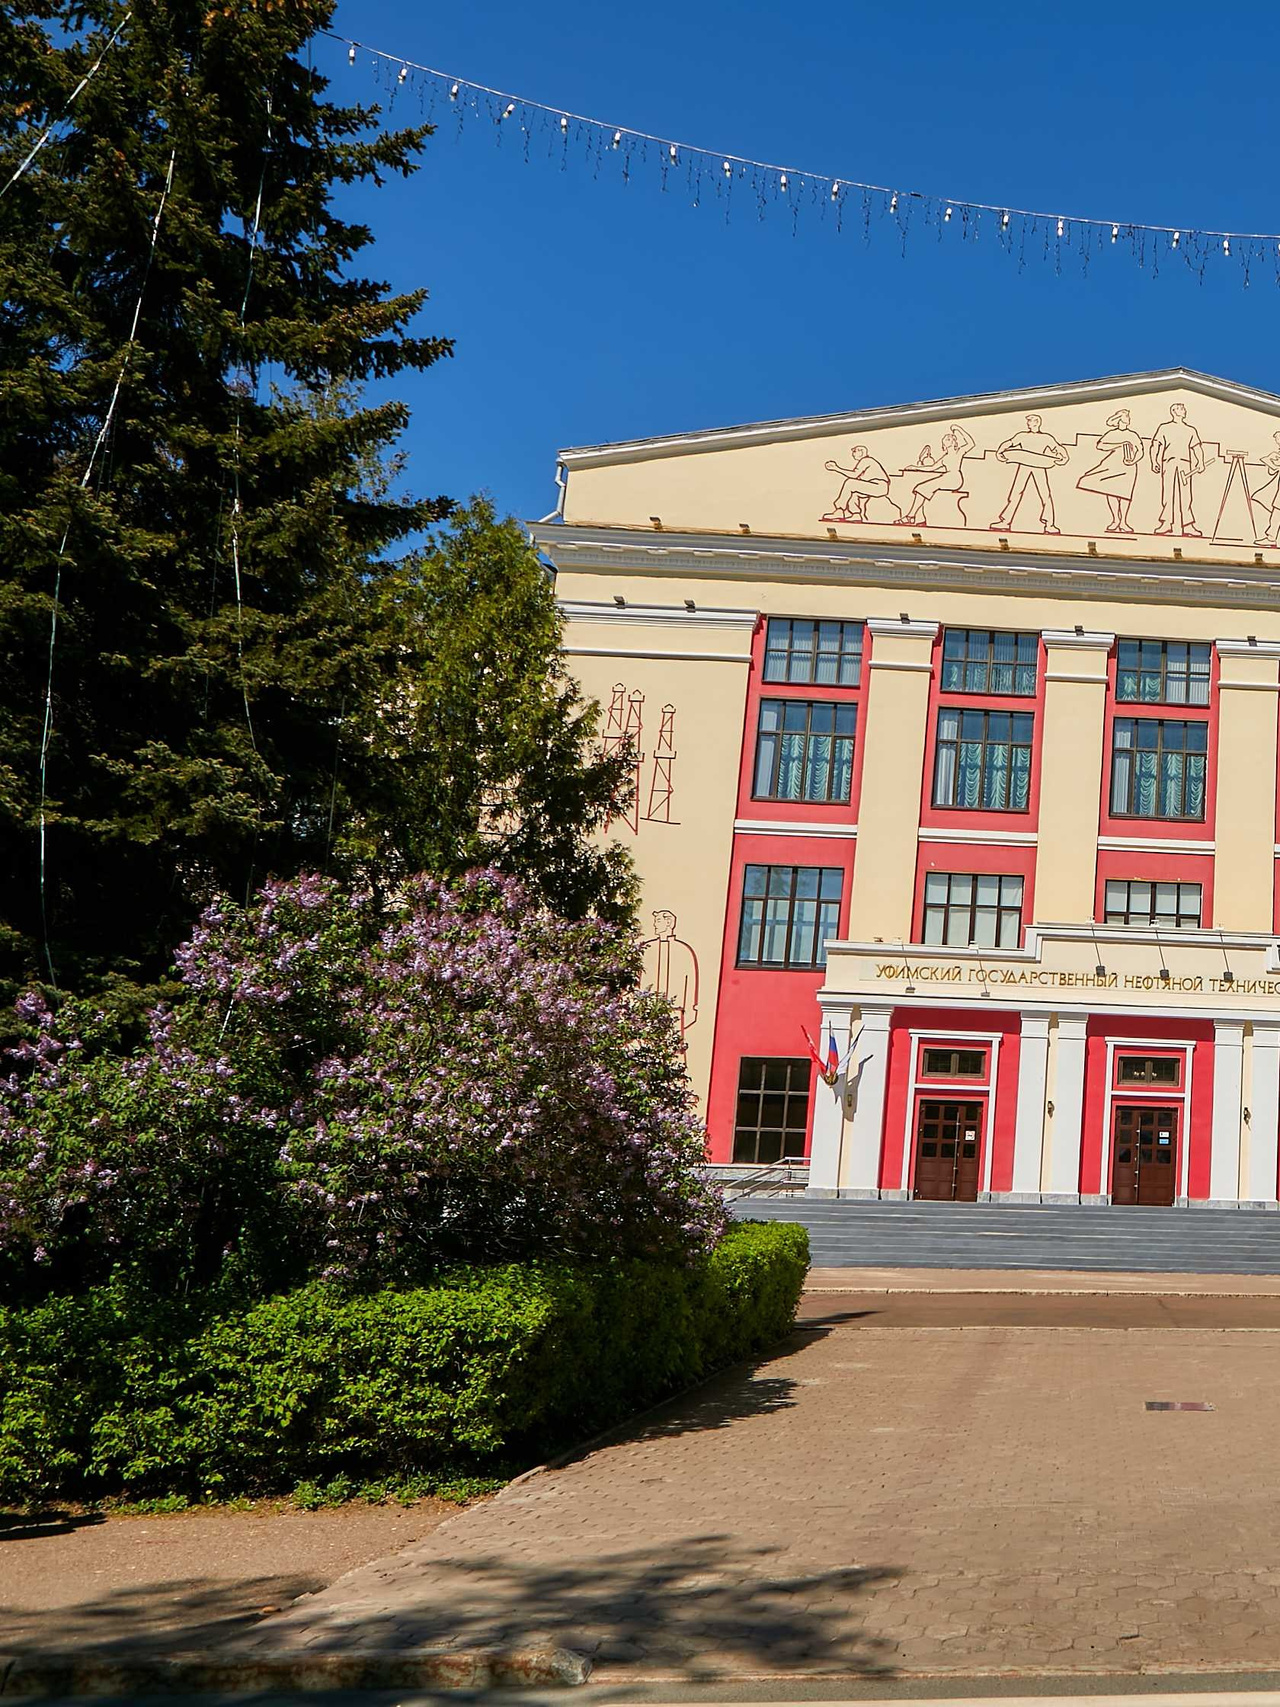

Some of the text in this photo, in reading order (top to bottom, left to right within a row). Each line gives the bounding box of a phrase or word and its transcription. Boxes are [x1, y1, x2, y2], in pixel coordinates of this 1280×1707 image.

[876, 964, 962, 981] УФИМСКИЙ
[968, 968, 1119, 988] ГОСУДАРСТВЕННЫЙ
[1124, 975, 1203, 991] НЕФТЯНОЙ
